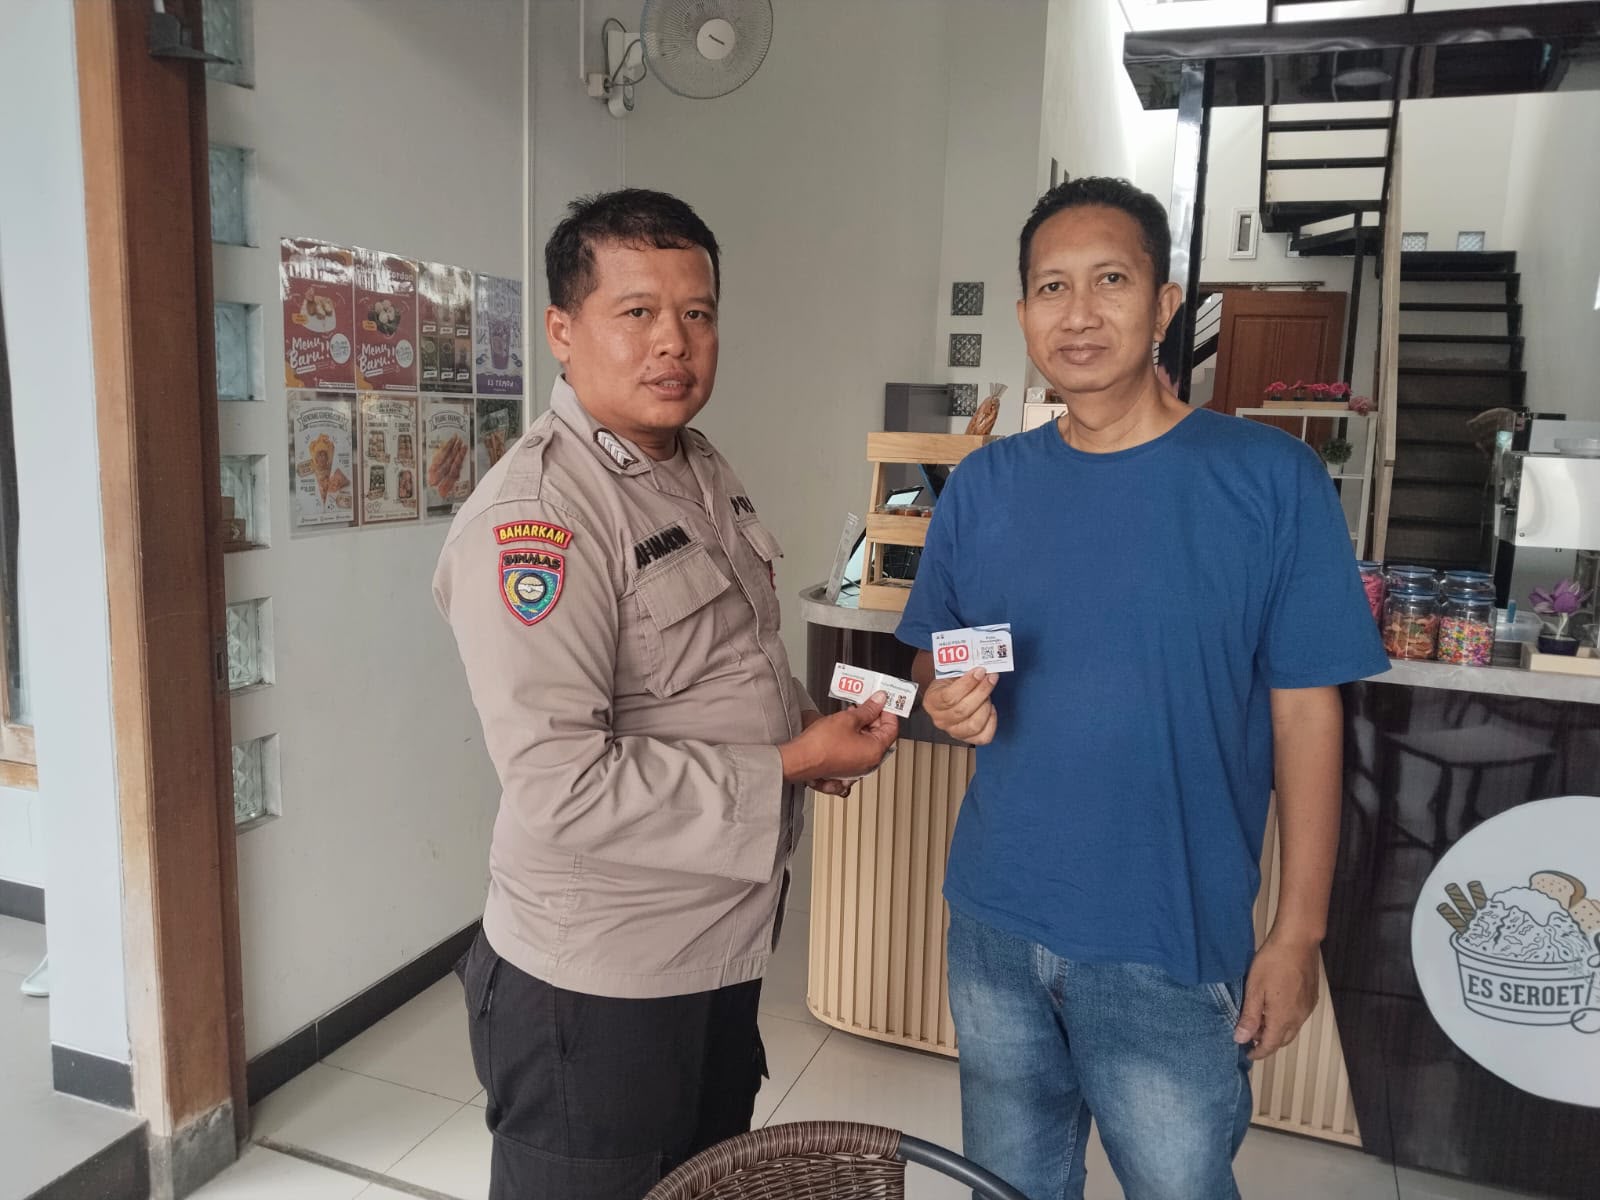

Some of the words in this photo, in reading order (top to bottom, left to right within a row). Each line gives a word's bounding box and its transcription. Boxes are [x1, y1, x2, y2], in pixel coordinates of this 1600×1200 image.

[291, 336, 321, 351] Menu
[361, 343, 388, 357] Menu
[499, 524, 566, 544] BAHARKAM
[939, 646, 967, 662] 110
[840, 677, 863, 693] 110
[1467, 974, 1493, 999] ES
[1499, 982, 1585, 1006] SEROET
